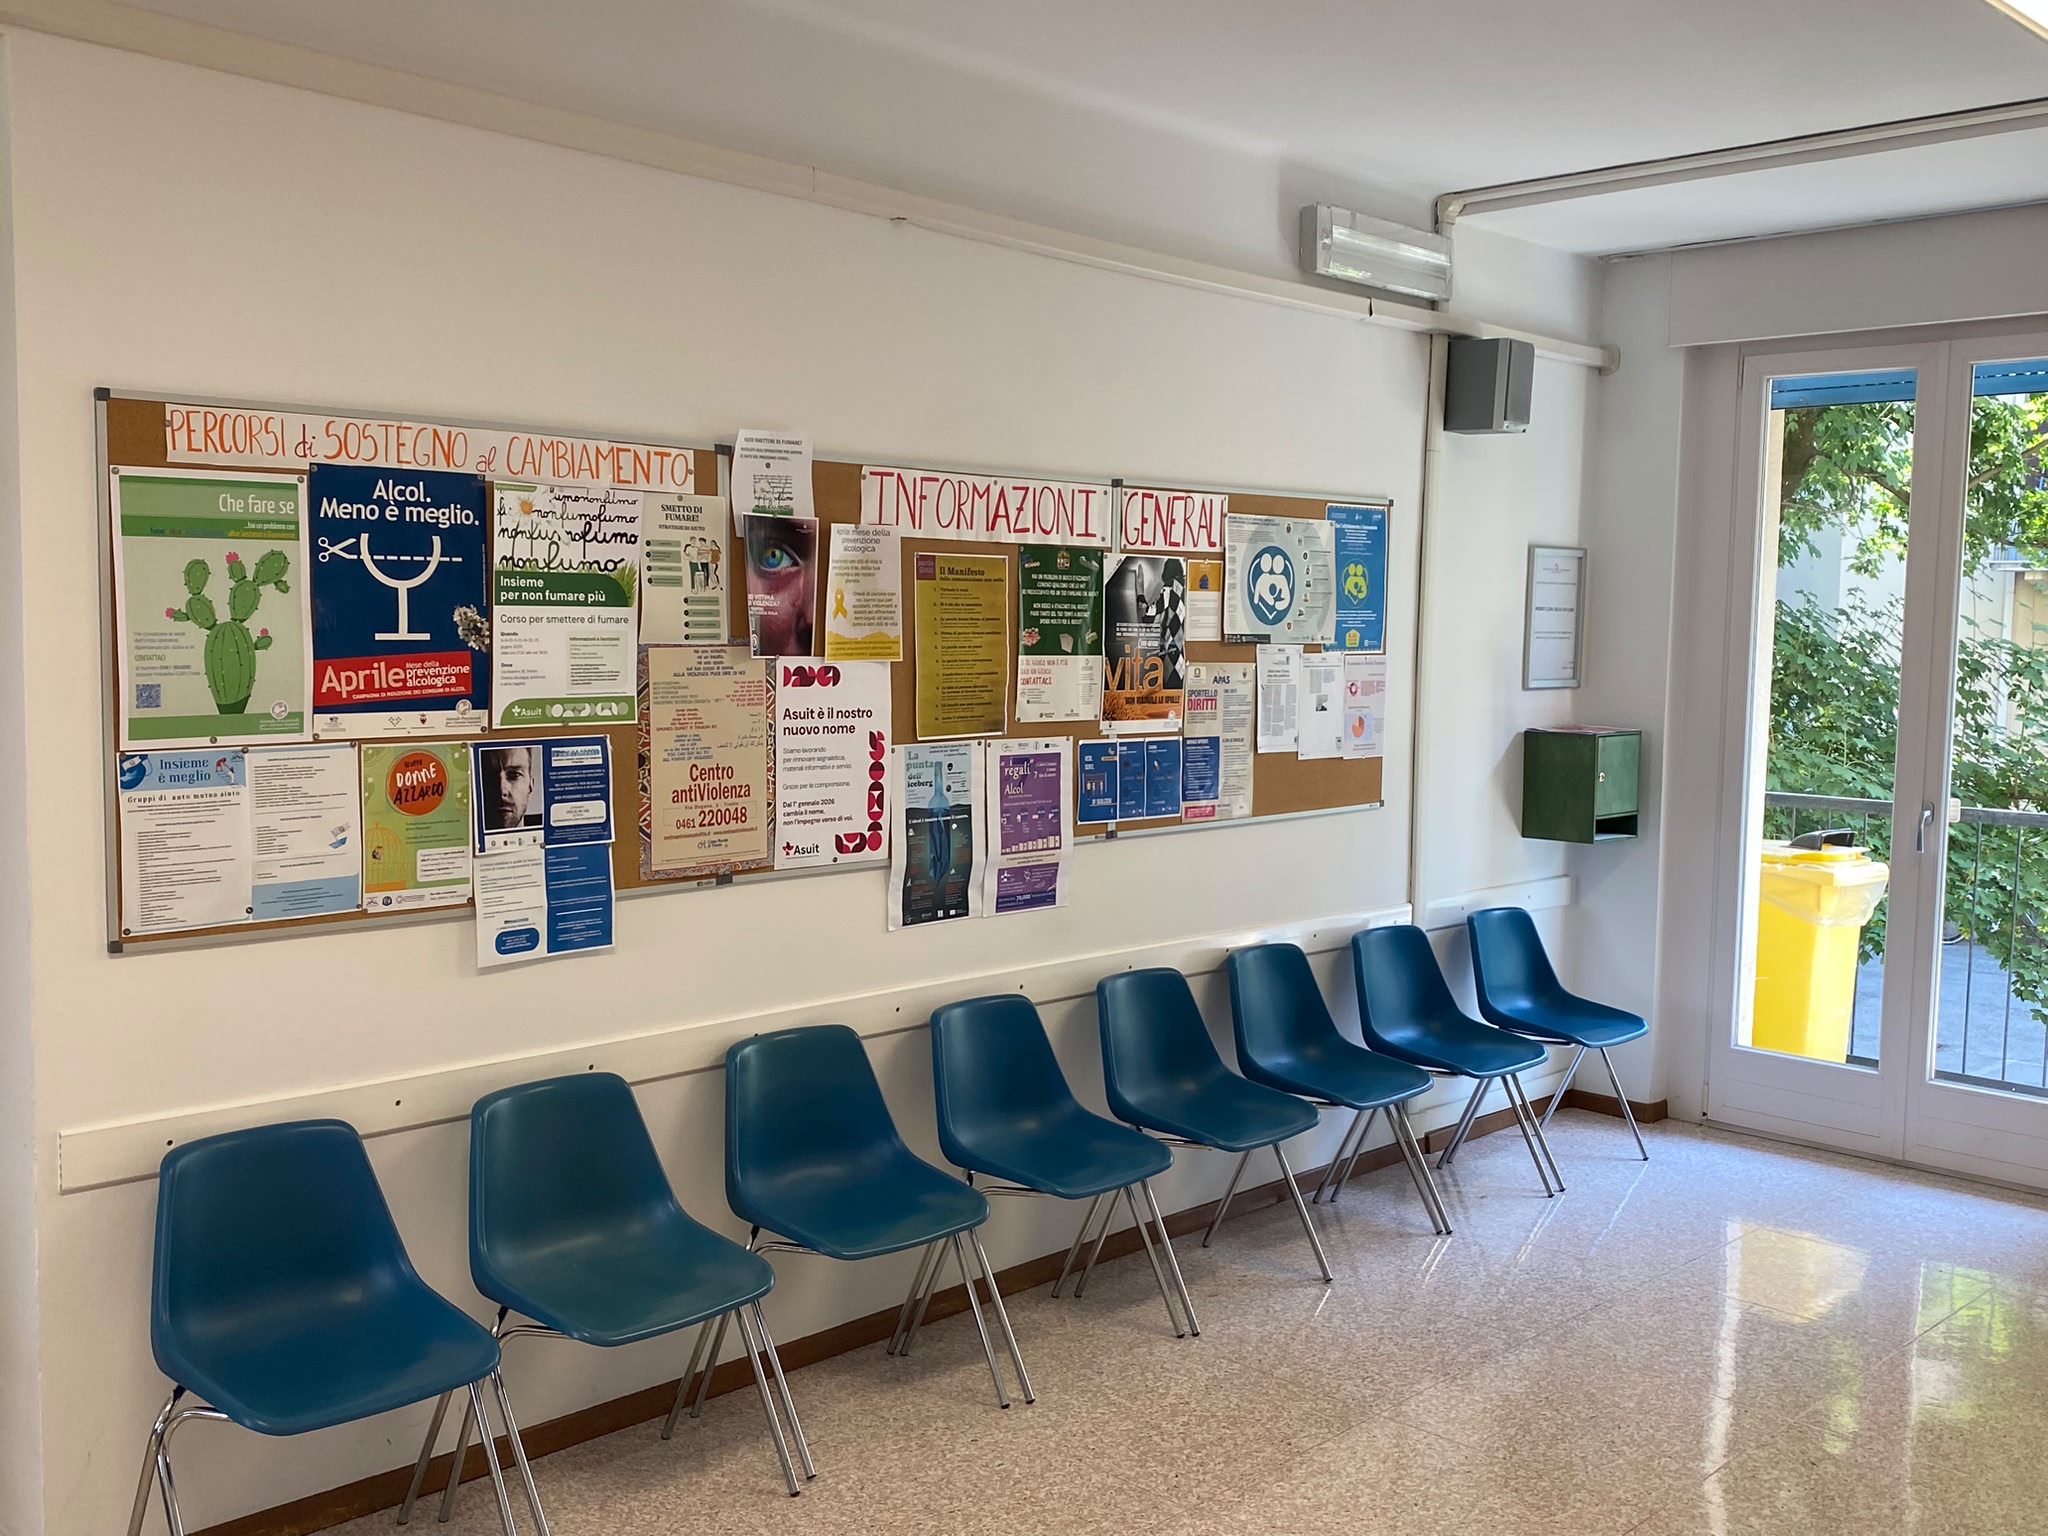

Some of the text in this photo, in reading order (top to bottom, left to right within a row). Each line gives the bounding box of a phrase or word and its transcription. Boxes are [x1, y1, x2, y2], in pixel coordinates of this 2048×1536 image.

[169, 408, 691, 487] PERCORSI di SOSTEGNO al CAMBIAMENTO
[372, 478, 432, 503] Alcol.
[218, 493, 296, 514] Che fare se
[660, 504, 703, 514] SMETTO DI
[868, 470, 1098, 539] INFORMAZIONI
[1124, 490, 1225, 548] GENERALI
[319, 497, 481, 529] Meno è meglio.
[664, 513, 700, 522] FUMARE!
[872, 528, 891, 537] della
[841, 537, 881, 545] prevenzione
[842, 544, 876, 554] alcologica
[499, 540, 626, 573] nonfumo
[939, 566, 986, 577] Il Manifesto
[500, 576, 544, 588] Insieme
[500, 590, 606, 605] per non fumare più
[500, 614, 630, 626] Corso per smettere di fumare
[405, 660, 440, 669] Mese della
[1104, 644, 1165, 693] vita
[406, 664, 471, 680] prevenzione
[320, 661, 406, 699] Aprile
[406, 674, 457, 688] alcologica
[1212, 675, 1231, 684] APAS
[1187, 689, 1218, 698] SPORTELLO
[1187, 698, 1218, 712] DIRITTI
[520, 707, 542, 717] Asuit
[782, 706, 873, 721] Asuit è il nostro
[783, 724, 856, 736] nuovo nome
[782, 746, 827, 755] Stiamo lavorando
[908, 751, 919, 761] La
[160, 758, 210, 770] Insieme
[792, 756, 816, 764] rinnovare
[906, 760, 934, 772] punta
[690, 763, 734, 782] Centro
[908, 772, 924, 780] dell'
[1004, 761, 1031, 780] regali
[158, 770, 211, 784] è meglio
[782, 783, 799, 791] Grazie
[907, 780, 934, 788] iceberg
[1004, 782, 1024, 796] Alcol
[128, 794, 156, 804] Gruppi
[158, 794, 167, 802] di
[220, 790, 241, 798] aiuto
[393, 781, 444, 806] AZZARDO
[672, 782, 751, 804] antiViolenza
[782, 801, 792, 809] Dal
[798, 800, 820, 809] gennaio
[676, 806, 748, 830] 0461 220048
[794, 818, 821, 827] l'impegno
[793, 843, 820, 856] Asuit
